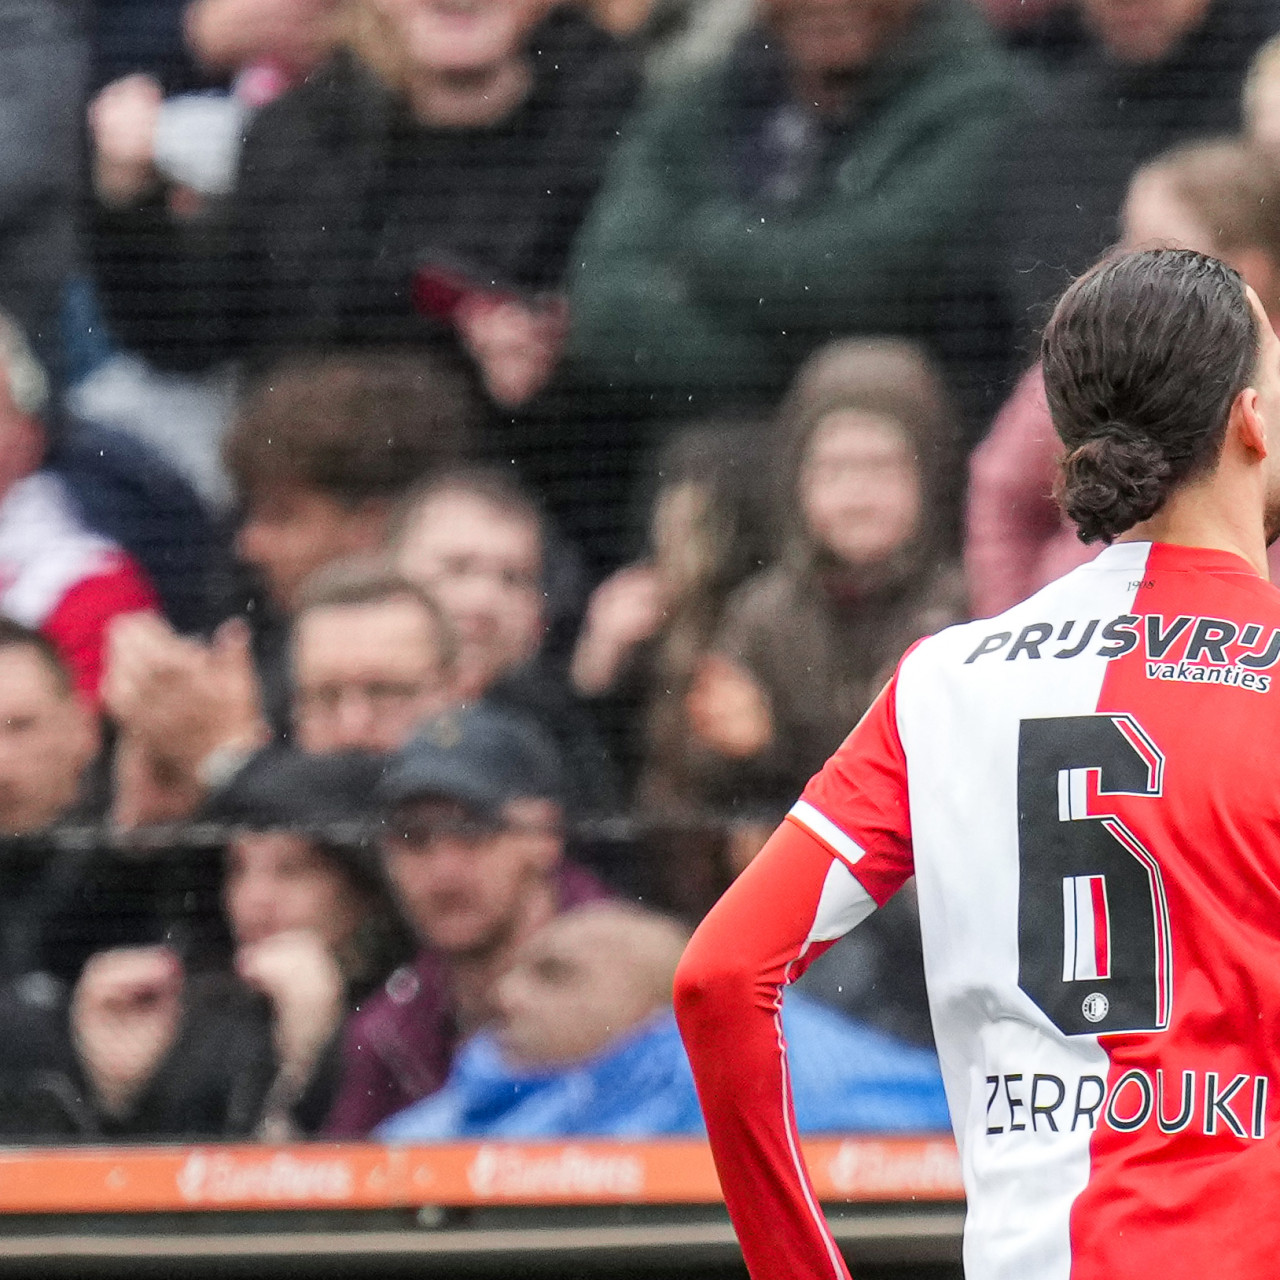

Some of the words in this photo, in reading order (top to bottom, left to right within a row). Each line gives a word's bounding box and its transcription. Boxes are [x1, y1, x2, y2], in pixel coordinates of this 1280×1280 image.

[1146, 660, 1271, 693] vakanties
[1017, 711, 1173, 1036] 6
[985, 1069, 1268, 1140] ZERROUKI
